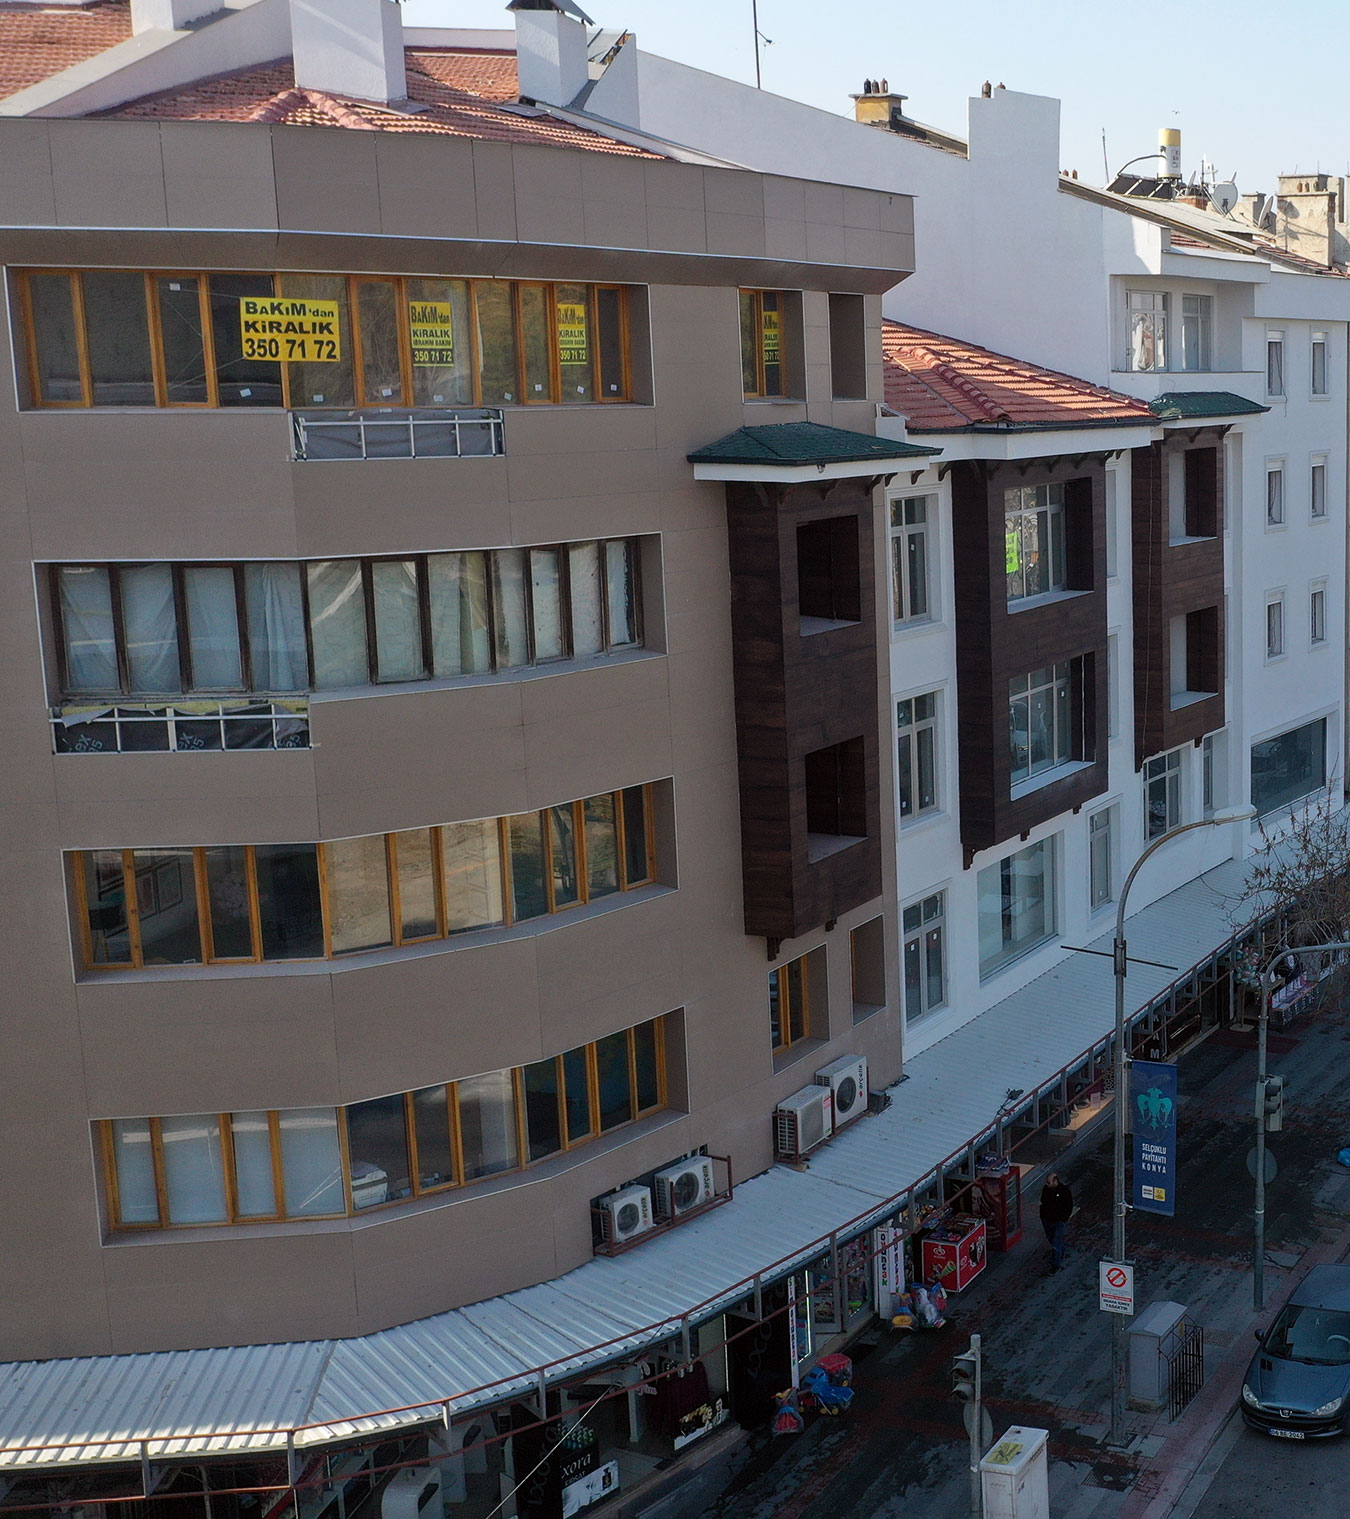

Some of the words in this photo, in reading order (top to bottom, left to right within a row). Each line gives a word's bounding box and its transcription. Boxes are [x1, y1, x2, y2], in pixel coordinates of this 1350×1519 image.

[244, 338, 280, 358] 350
[286, 339, 307, 359] 71
[313, 340, 337, 360] 72
[560, 350, 571, 360] 350
[571, 350, 578, 360] 71
[578, 350, 586, 360] 72
[414, 351, 429, 362] 350
[431, 351, 440, 362] 71
[442, 351, 453, 362] 72
[1141, 1162, 1167, 1175] KONYA
